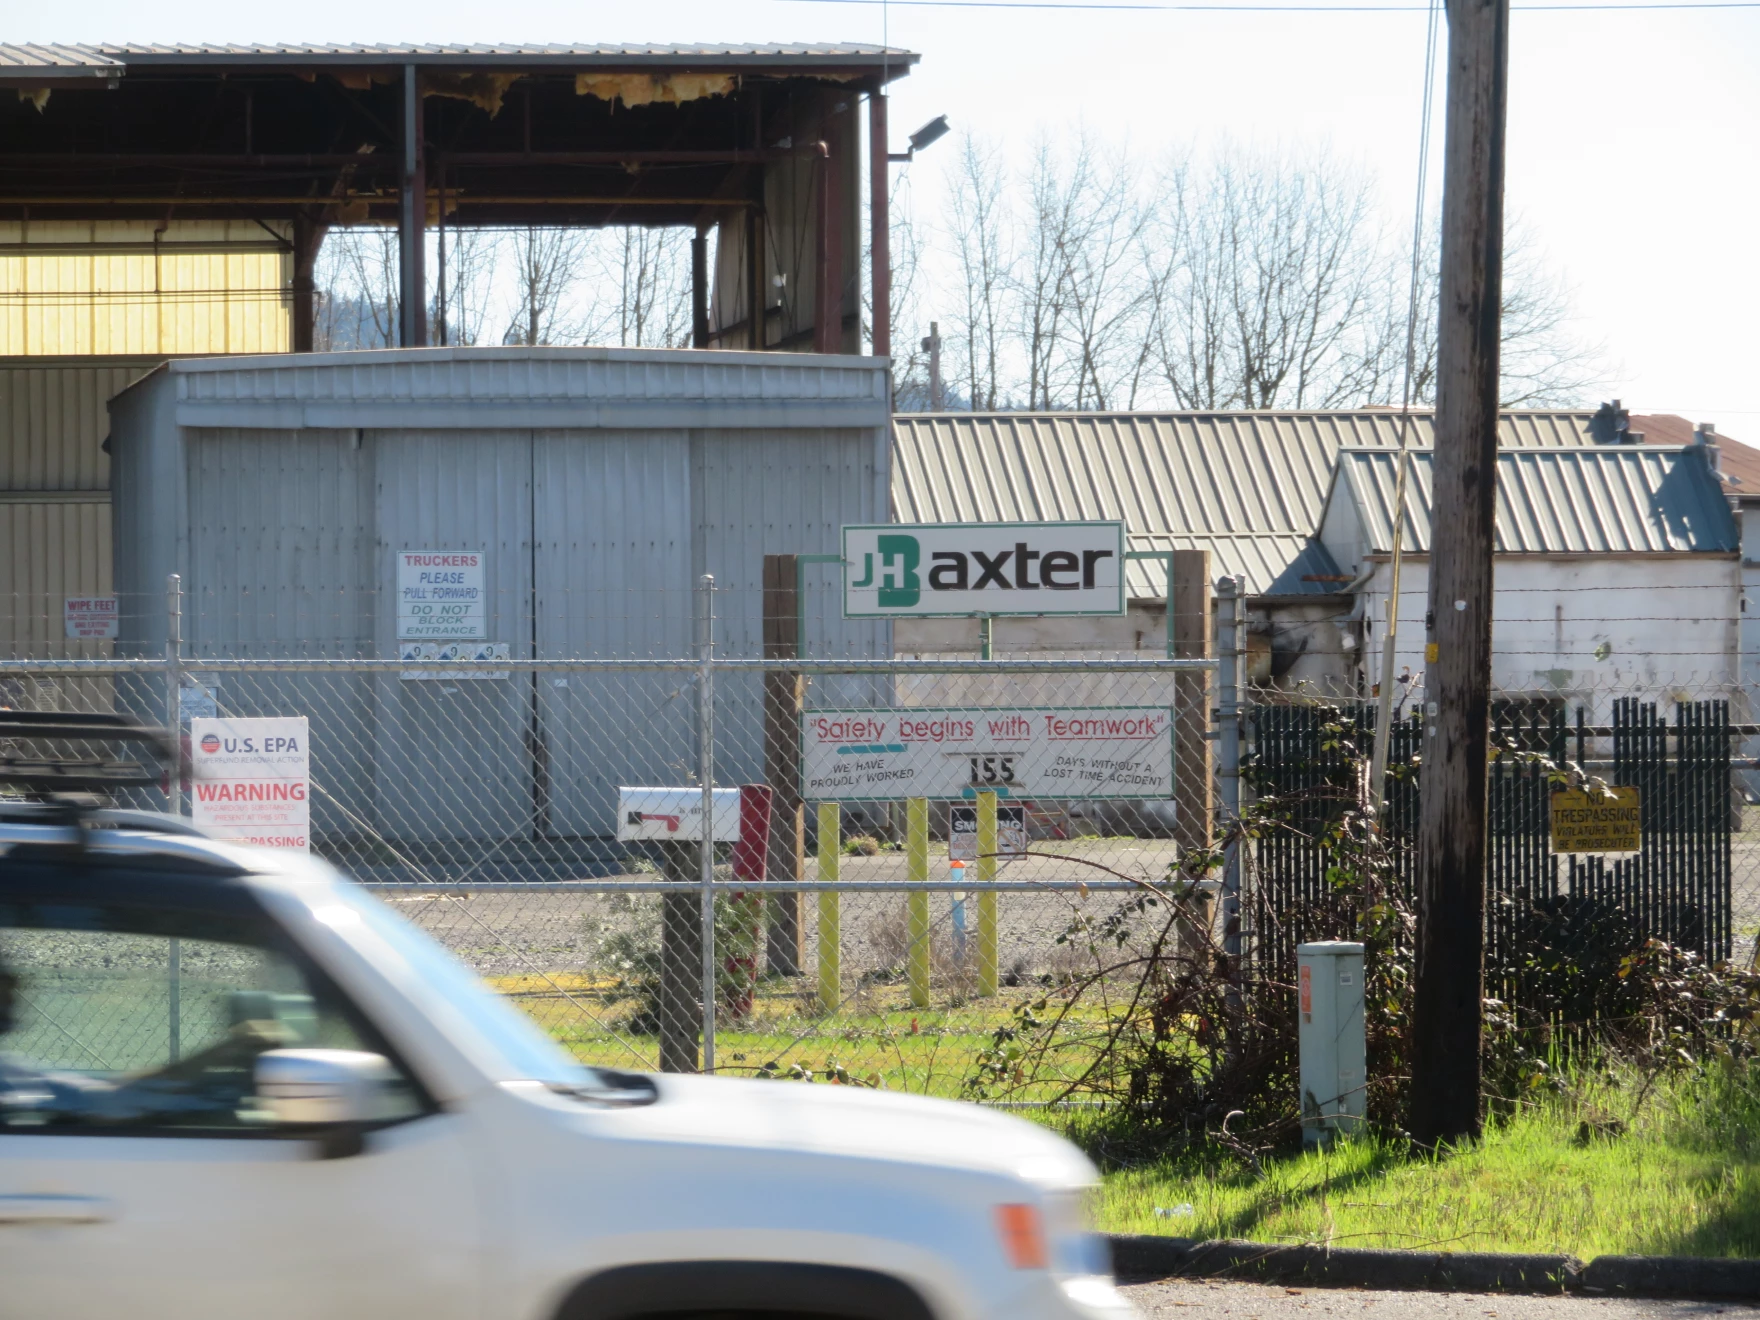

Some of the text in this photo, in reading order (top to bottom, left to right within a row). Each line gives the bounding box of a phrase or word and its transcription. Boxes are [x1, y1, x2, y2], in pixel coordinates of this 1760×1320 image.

[404, 555, 478, 567] TRUCKERS
[419, 572, 465, 584] PLEASE
[404, 587, 478, 599] PULL FORWARD
[67, 600, 116, 611] WIPE FEET
[411, 605, 472, 615] DO NOT
[418, 616, 464, 625] BLOCK
[405, 626, 477, 635] ENTRANCE
[900, 716, 974, 742] begins
[988, 715, 1030, 736] with
[224, 737, 299, 753] U.S. EPA
[197, 756, 240, 765] SUPERFUND
[241, 756, 275, 764] REMOVAL
[833, 759, 884, 774] WE HAVE
[1056, 756, 1152, 773] DAYS WITHOUT A
[970, 757, 1015, 783] 155
[810, 769, 914, 789] PROUDLY WORKED
[1043, 769, 1163, 787] LOST TIME ACCIDENT
[196, 782, 305, 802] WARNING
[1586, 792, 1605, 806] NO
[203, 803, 296, 812] HAZARDOUS SUBSTANCES
[214, 814, 244, 822] PRESENT
[257, 813, 272, 821] THIS
[1553, 807, 1638, 823] TRESPASSING
[1612, 823, 1635, 835] WILL
